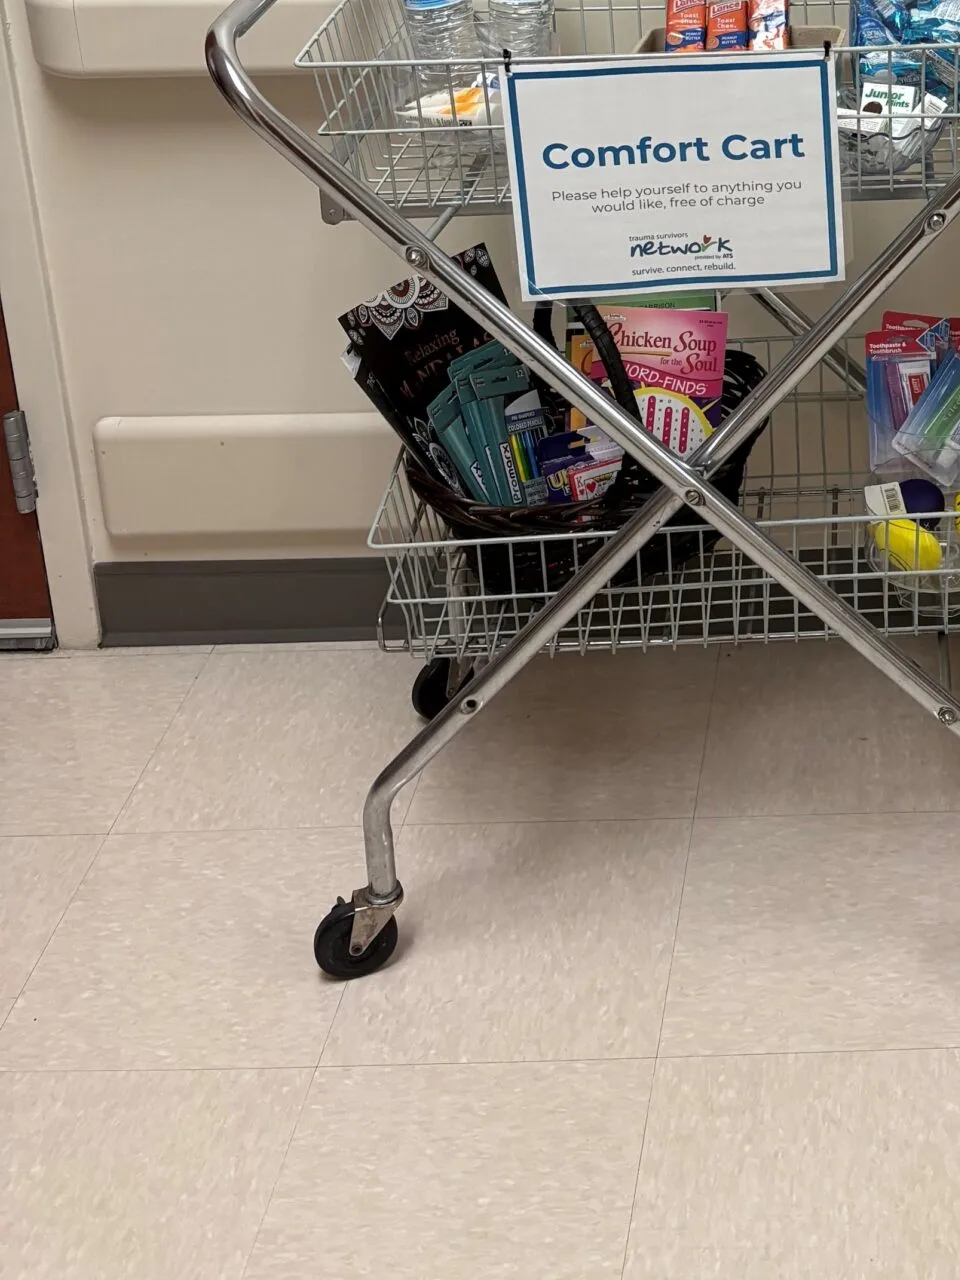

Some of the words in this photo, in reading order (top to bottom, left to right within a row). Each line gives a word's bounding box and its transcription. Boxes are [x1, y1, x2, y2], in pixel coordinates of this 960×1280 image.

[712, 2, 740, 13] Lance
[865, 88, 905, 100] Junor
[542, 136, 711, 169] Comfort
[721, 133, 806, 161] Cart
[551, 190, 598, 201] Please
[601, 186, 632, 200] help
[635, 183, 691, 199] yourself
[694, 183, 708, 193] to
[711, 180, 773, 194] anything
[776, 181, 802, 192] you
[591, 200, 635, 213] would
[639, 198, 667, 210] like,
[669, 196, 697, 207] free
[699, 195, 714, 207] of
[716, 195, 765, 207] charge
[628, 233, 655, 242] trauma
[656, 232, 689, 240] survivors
[630, 236, 733, 258] network
[704, 262, 736, 271] rebuild.
[404, 329, 460, 365] Relaxing
[608, 322, 672, 350] Chicken
[673, 330, 718, 356] Soup
[869, 342, 902, 350] Toothpaste
[516, 369, 524, 378] 12
[660, 357, 670, 366] for
[671, 357, 683, 367] the
[681, 352, 718, 375] Soul
[626, 363, 707, 396] ORD-FINDS
[503, 445, 521, 502] Promarx
